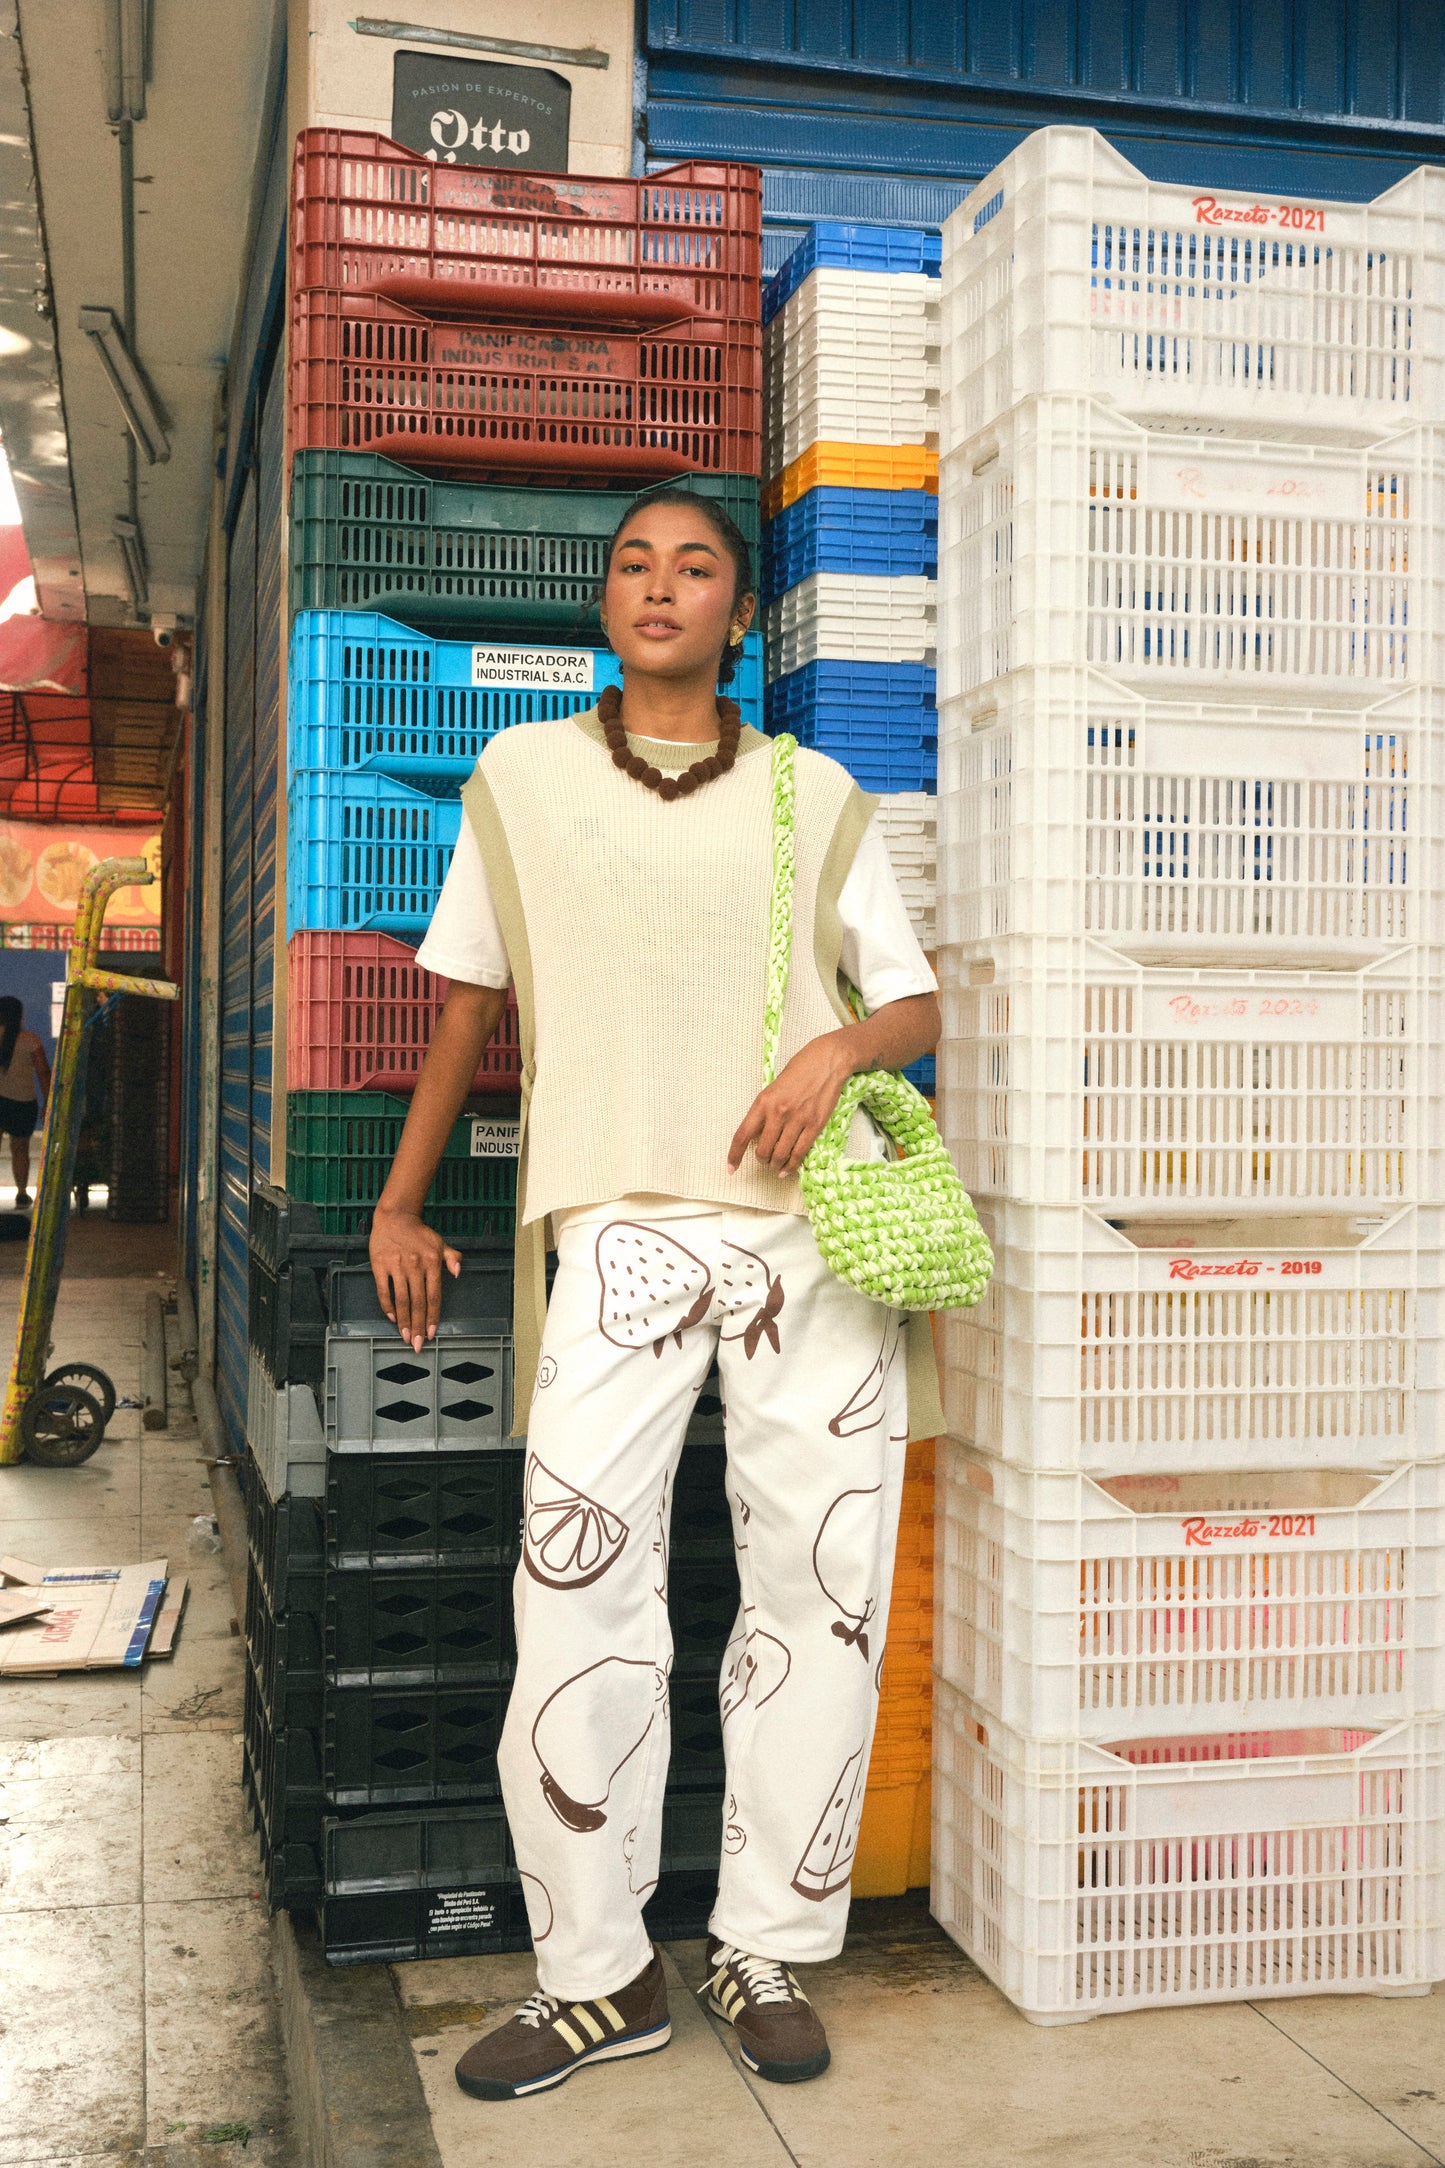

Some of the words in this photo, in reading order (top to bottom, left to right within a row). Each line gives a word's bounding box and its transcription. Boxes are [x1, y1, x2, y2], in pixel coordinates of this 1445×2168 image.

[412, 83, 459, 98] PASIÓN
[466, 83, 482, 93] DE
[488, 86, 553, 116] EXPERTOS
[430, 108, 531, 156] Otto
[476, 652, 588, 668] PANIFICADORA
[476, 668, 549, 682] INDUSTRIAL
[552, 671, 588, 684] S.A.C.
[476, 1126, 520, 1138] PANIF
[475, 1141, 520, 1154] INDUST
[1168, 1259, 1263, 1280] Razzeto
[1281, 1261, 1322, 1275] 2019
